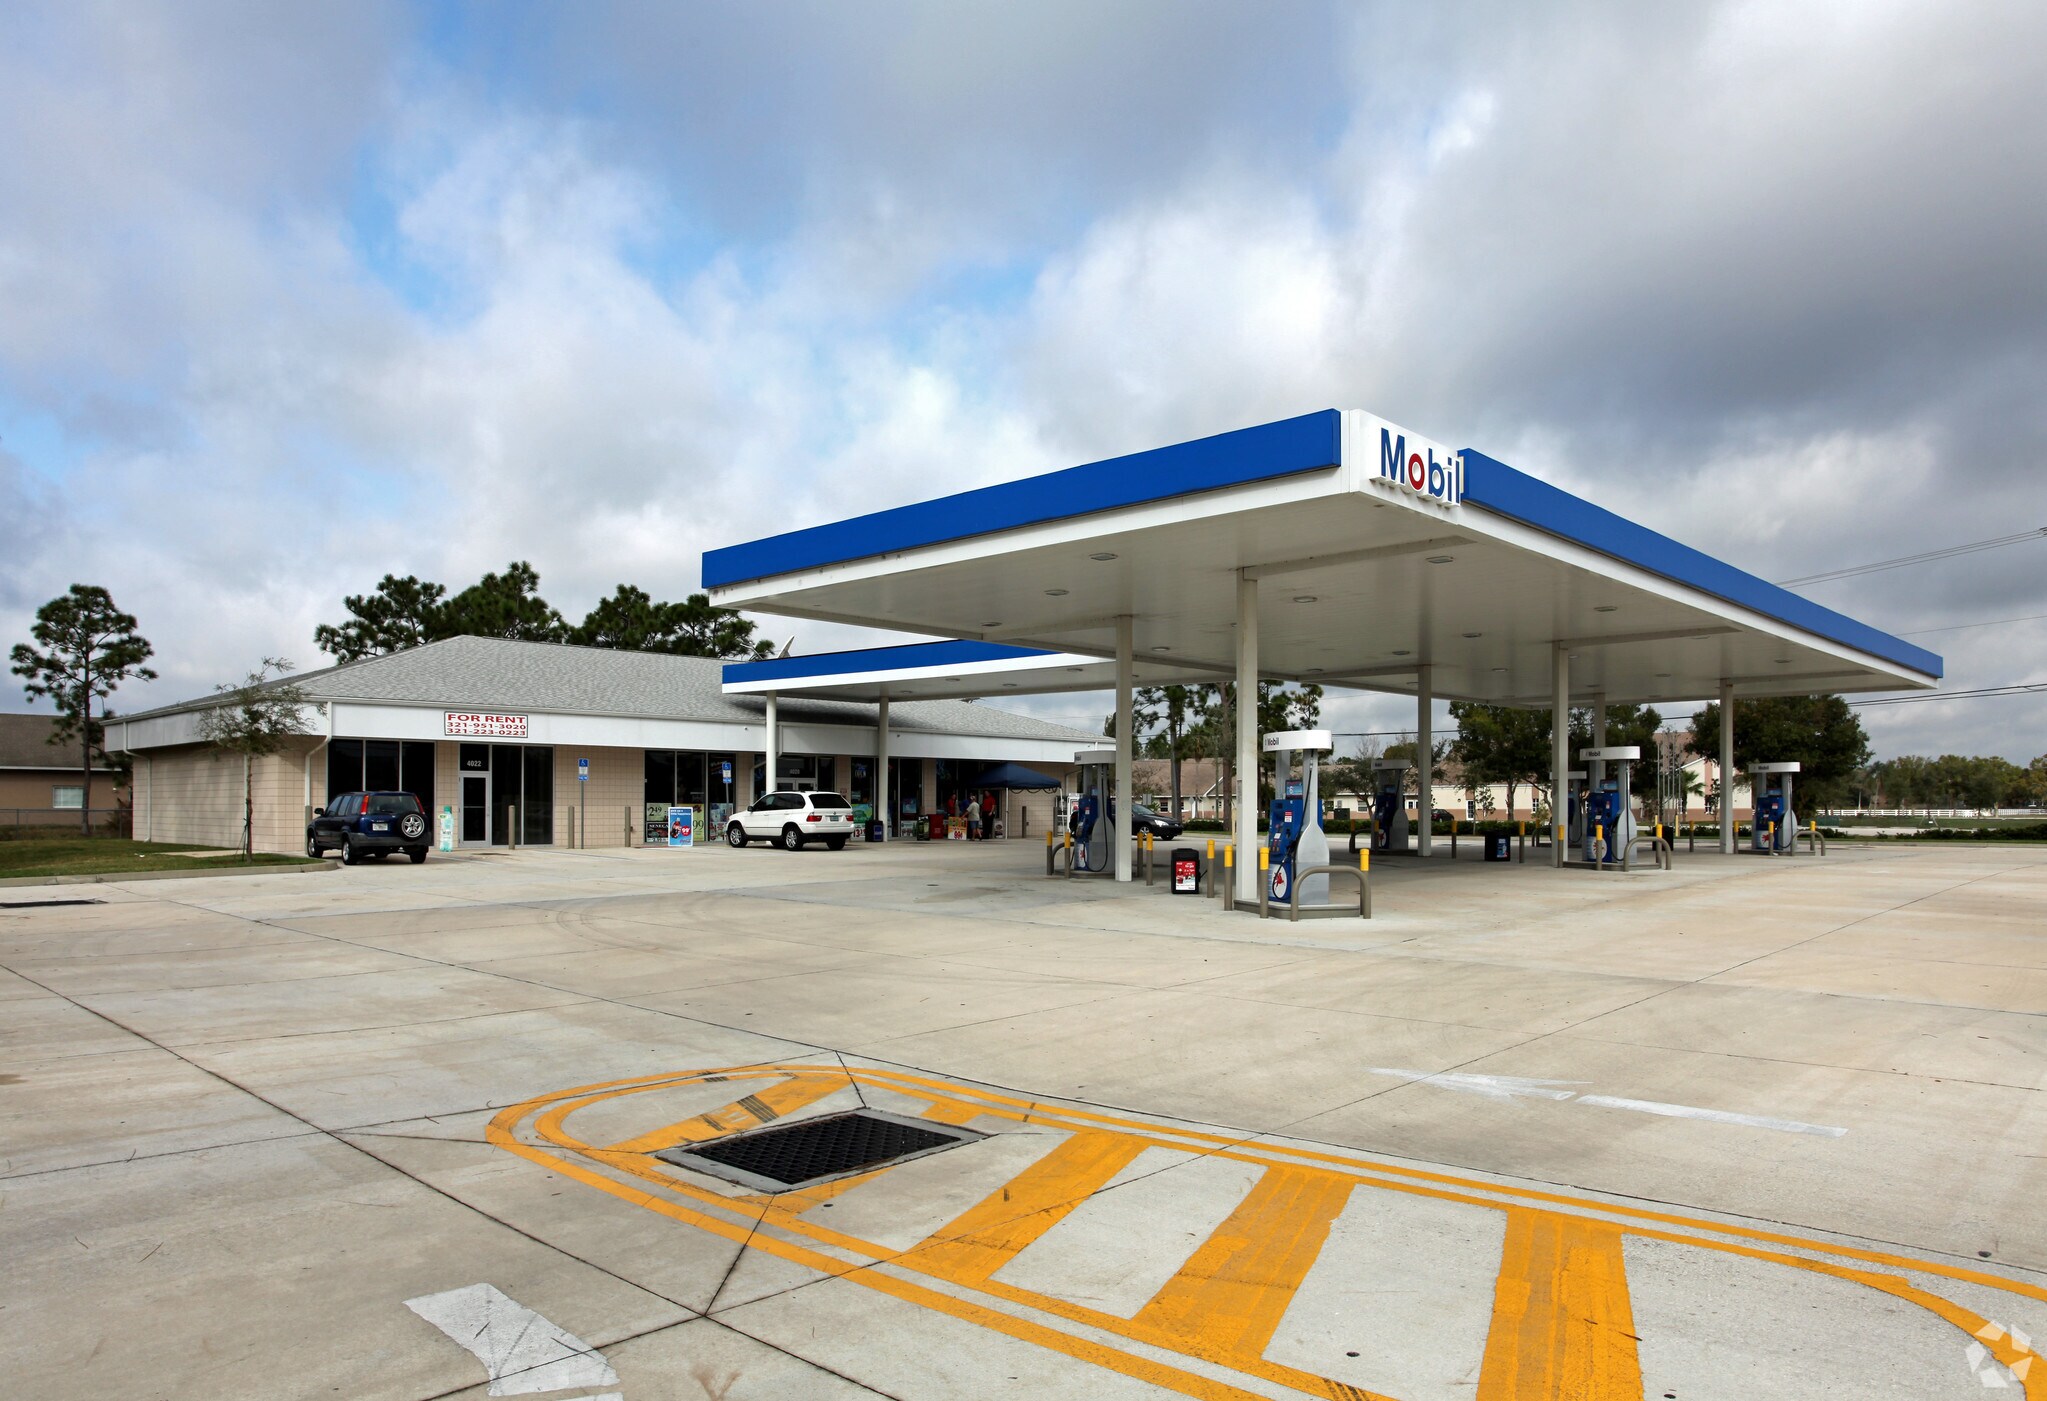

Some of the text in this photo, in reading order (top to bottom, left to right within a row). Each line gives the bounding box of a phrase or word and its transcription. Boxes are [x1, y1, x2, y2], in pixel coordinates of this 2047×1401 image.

[1381, 427, 1460, 504] Mobil
[447, 714, 525, 723] FOR RENT
[447, 722, 526, 730] 321-951-3020
